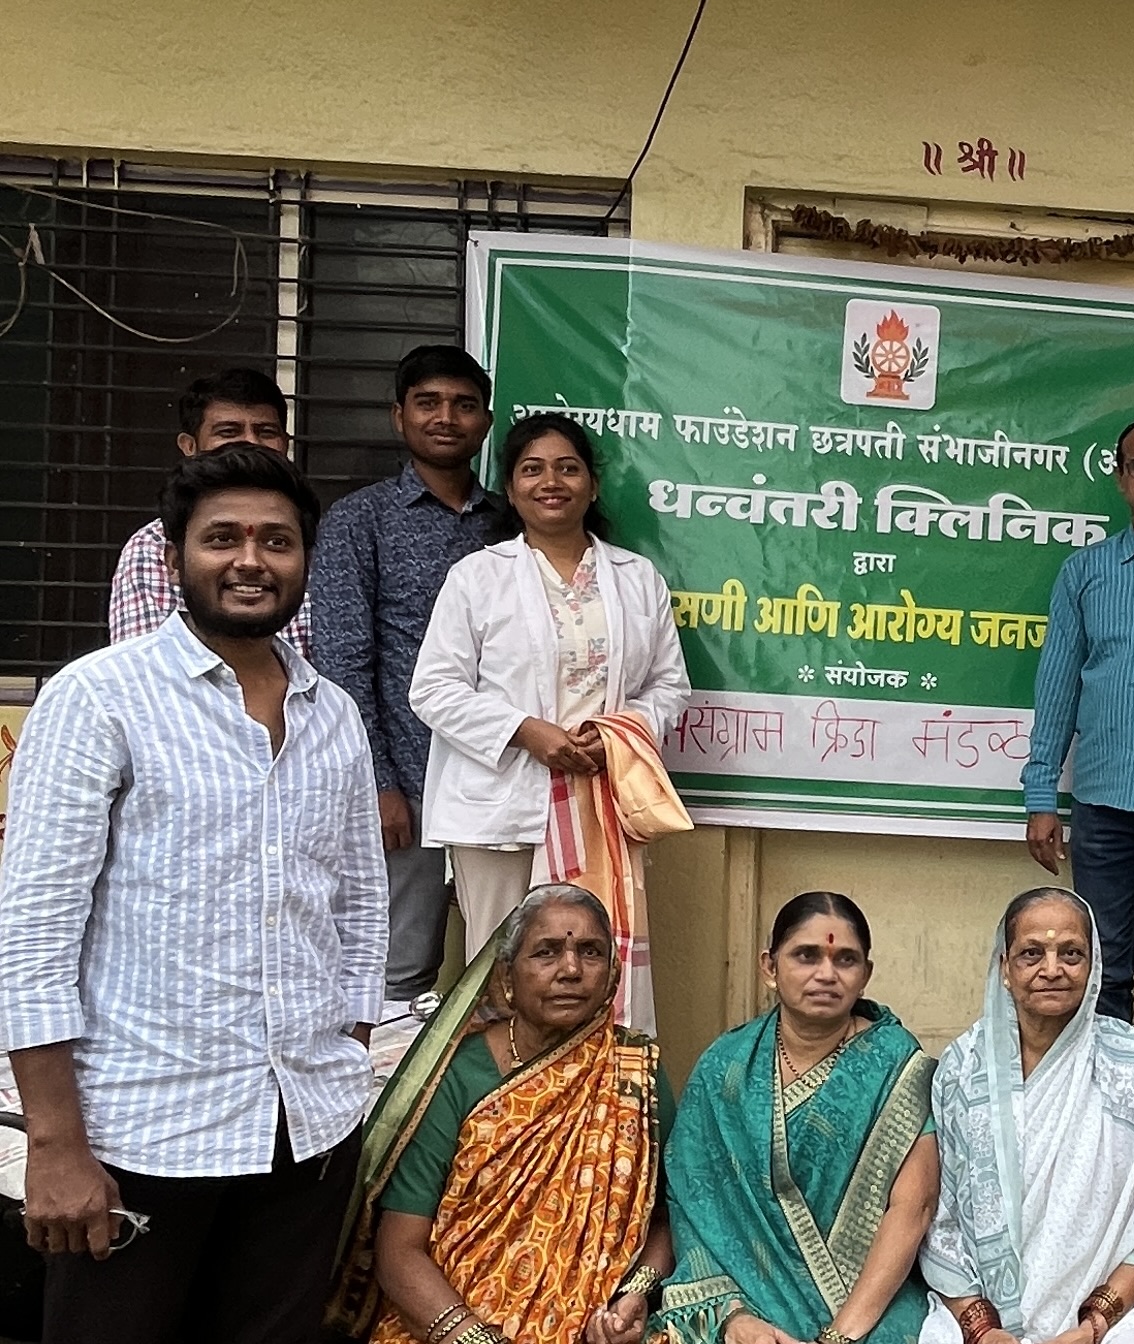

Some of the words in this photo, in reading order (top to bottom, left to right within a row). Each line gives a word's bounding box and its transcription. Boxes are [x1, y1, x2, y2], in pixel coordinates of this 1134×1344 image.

[957, 137, 998, 182] श्री
[673, 407, 799, 453] फाउंडेशन
[809, 420, 907, 461] छत्रपती
[916, 423, 1071, 474] संभाजीनगर
[648, 473, 863, 532] धन्वंतरी
[875, 484, 1110, 547] क्लिनिक
[852, 551, 897, 576] द्वारा
[670, 578, 748, 632] सणी
[754, 583, 841, 638] आणि
[846, 589, 965, 646] आरोग्य
[970, 611, 1048, 650] जनज
[824, 659, 910, 689] संयोजक
